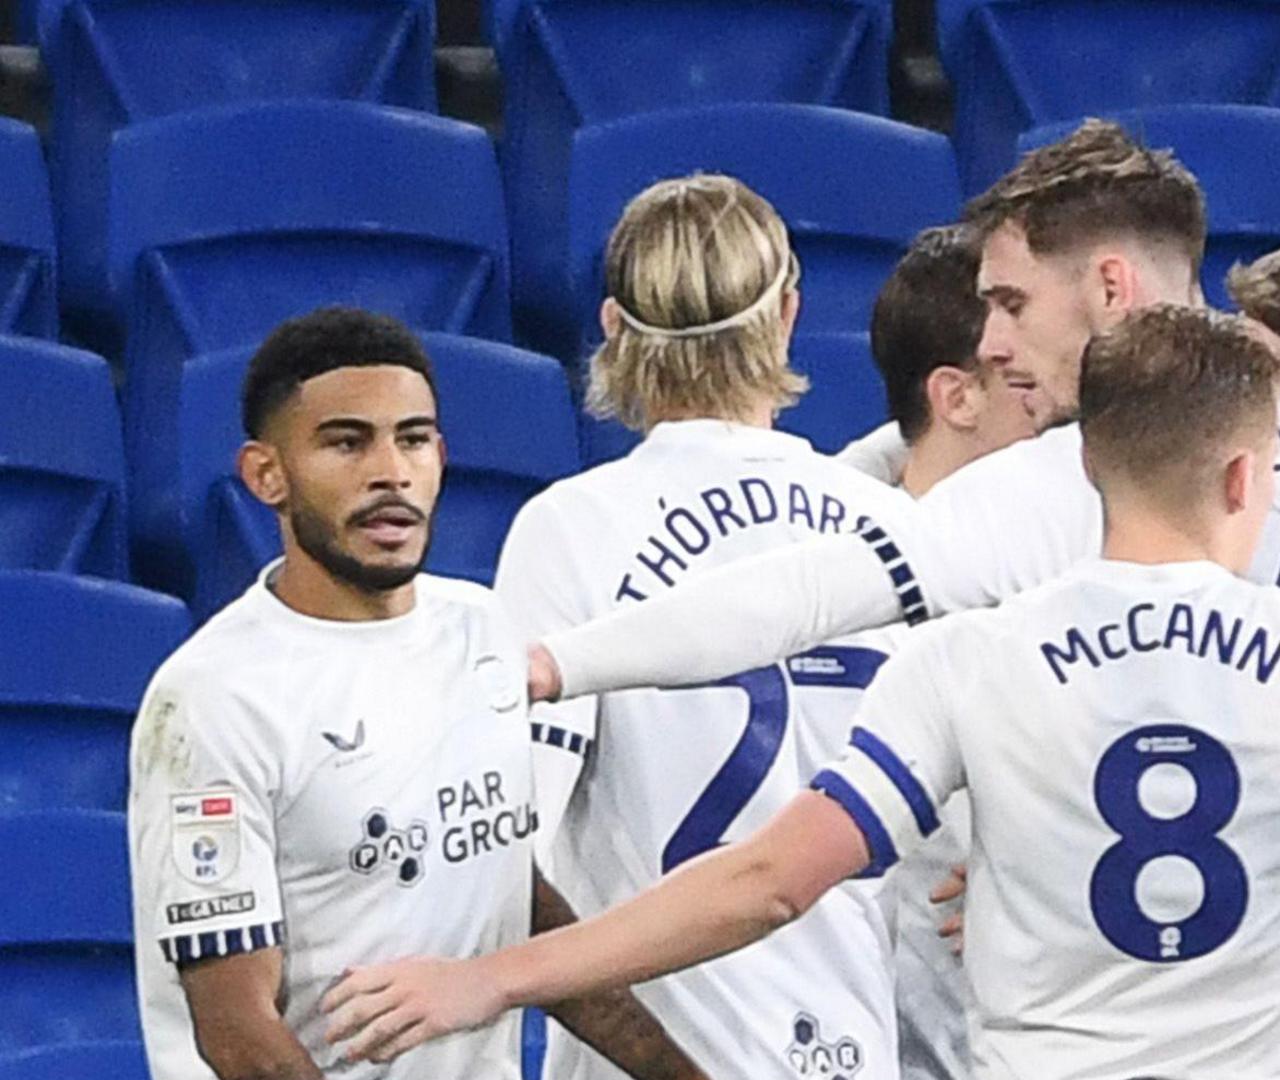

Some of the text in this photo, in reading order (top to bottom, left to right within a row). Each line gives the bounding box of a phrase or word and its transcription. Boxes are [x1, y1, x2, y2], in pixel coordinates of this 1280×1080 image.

[437, 770, 506, 823] PAR
[442, 803, 539, 863] GROU
[1089, 723, 1250, 964] 8
